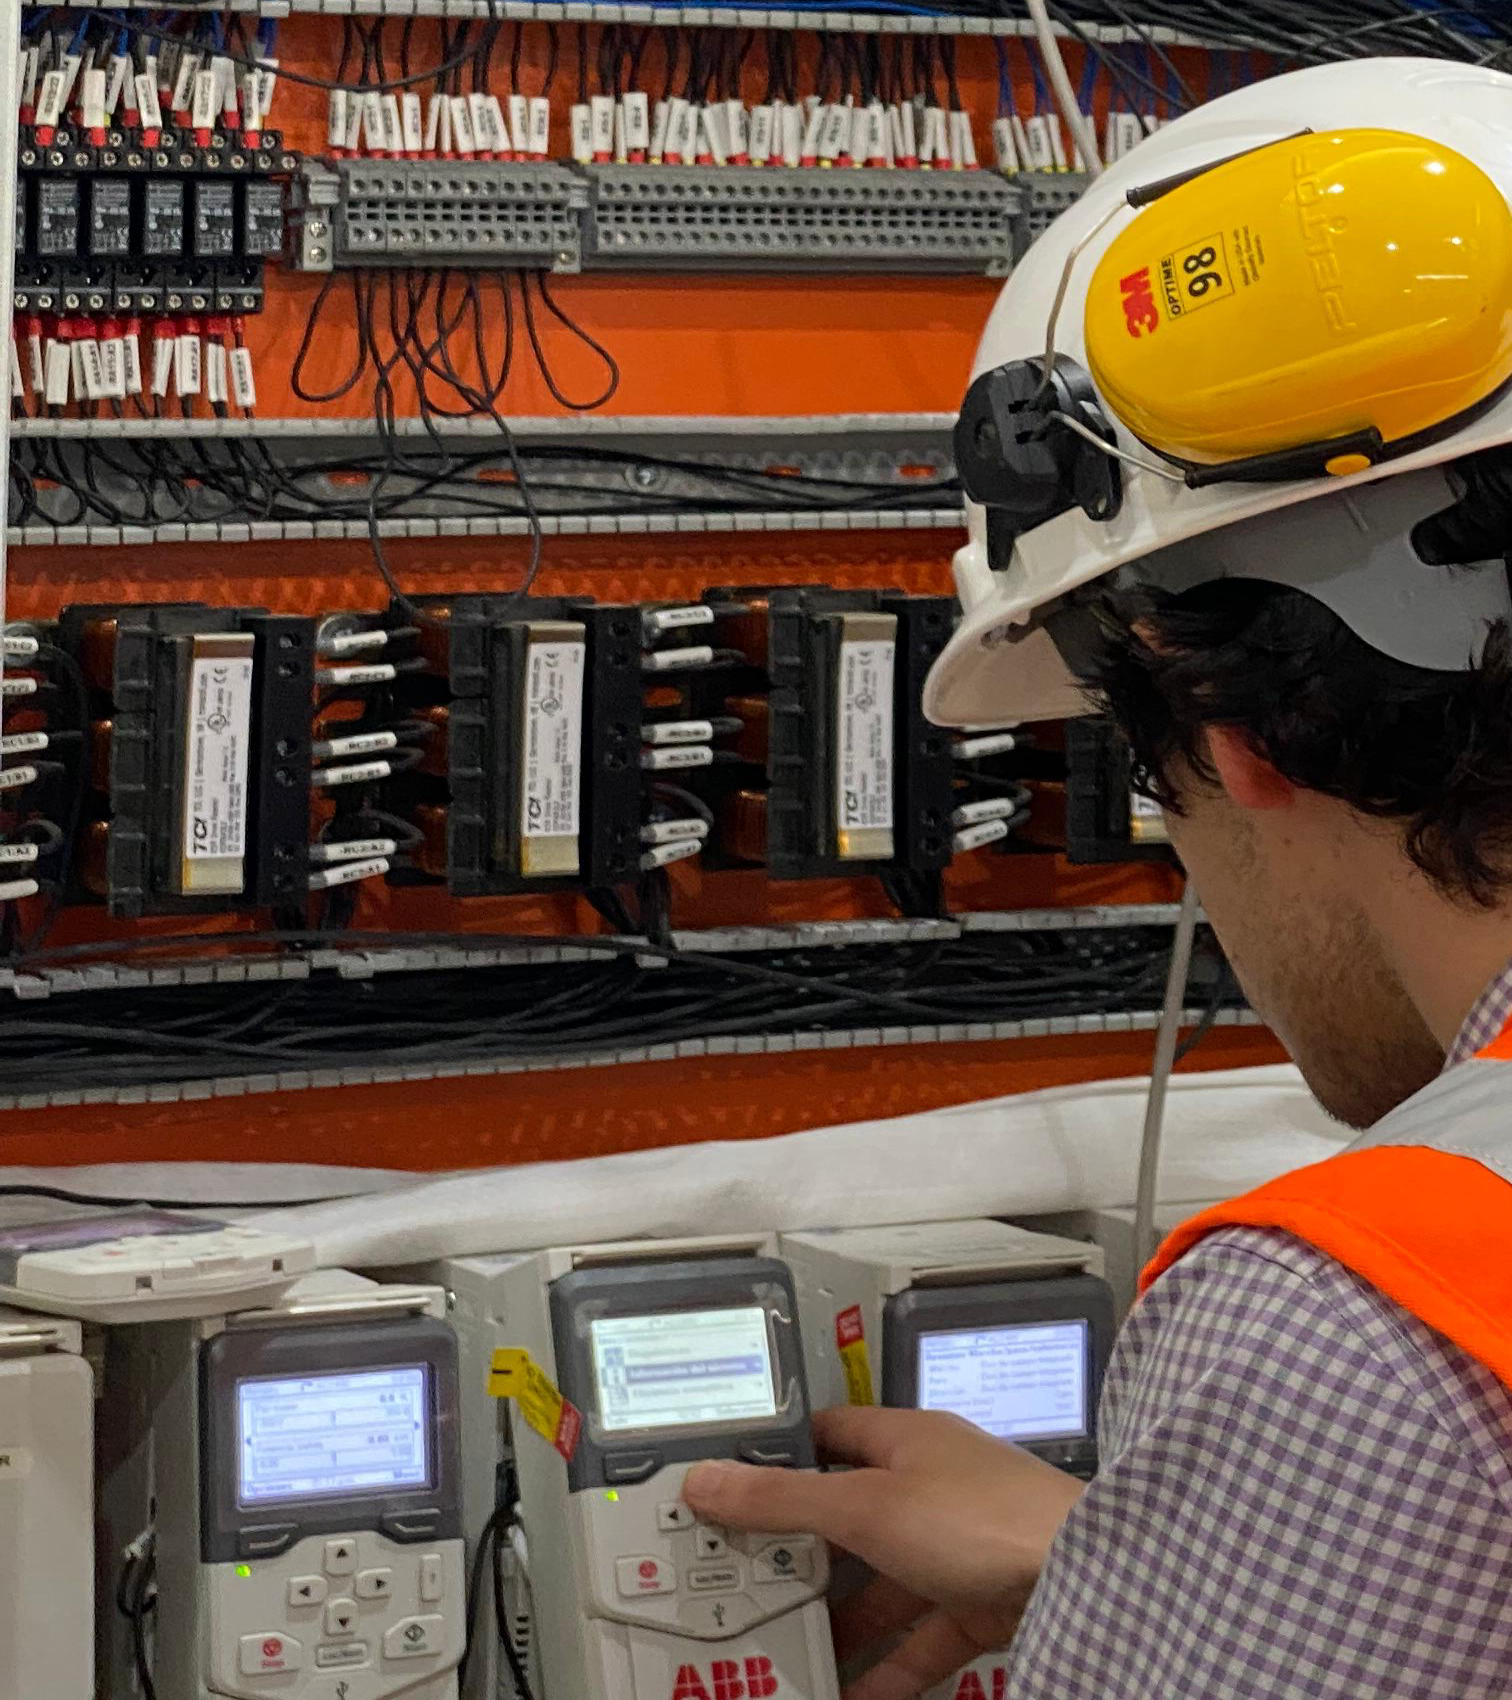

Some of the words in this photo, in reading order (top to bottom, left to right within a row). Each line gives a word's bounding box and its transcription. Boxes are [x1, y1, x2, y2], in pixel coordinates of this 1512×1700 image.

[1184, 246, 1222, 298] 98
[1291, 151, 1358, 337] PELTOR
[1120, 266, 1159, 338] 3M
[1161, 256, 1182, 316] OPTIME
[671, 1655, 779, 1700] ABB
